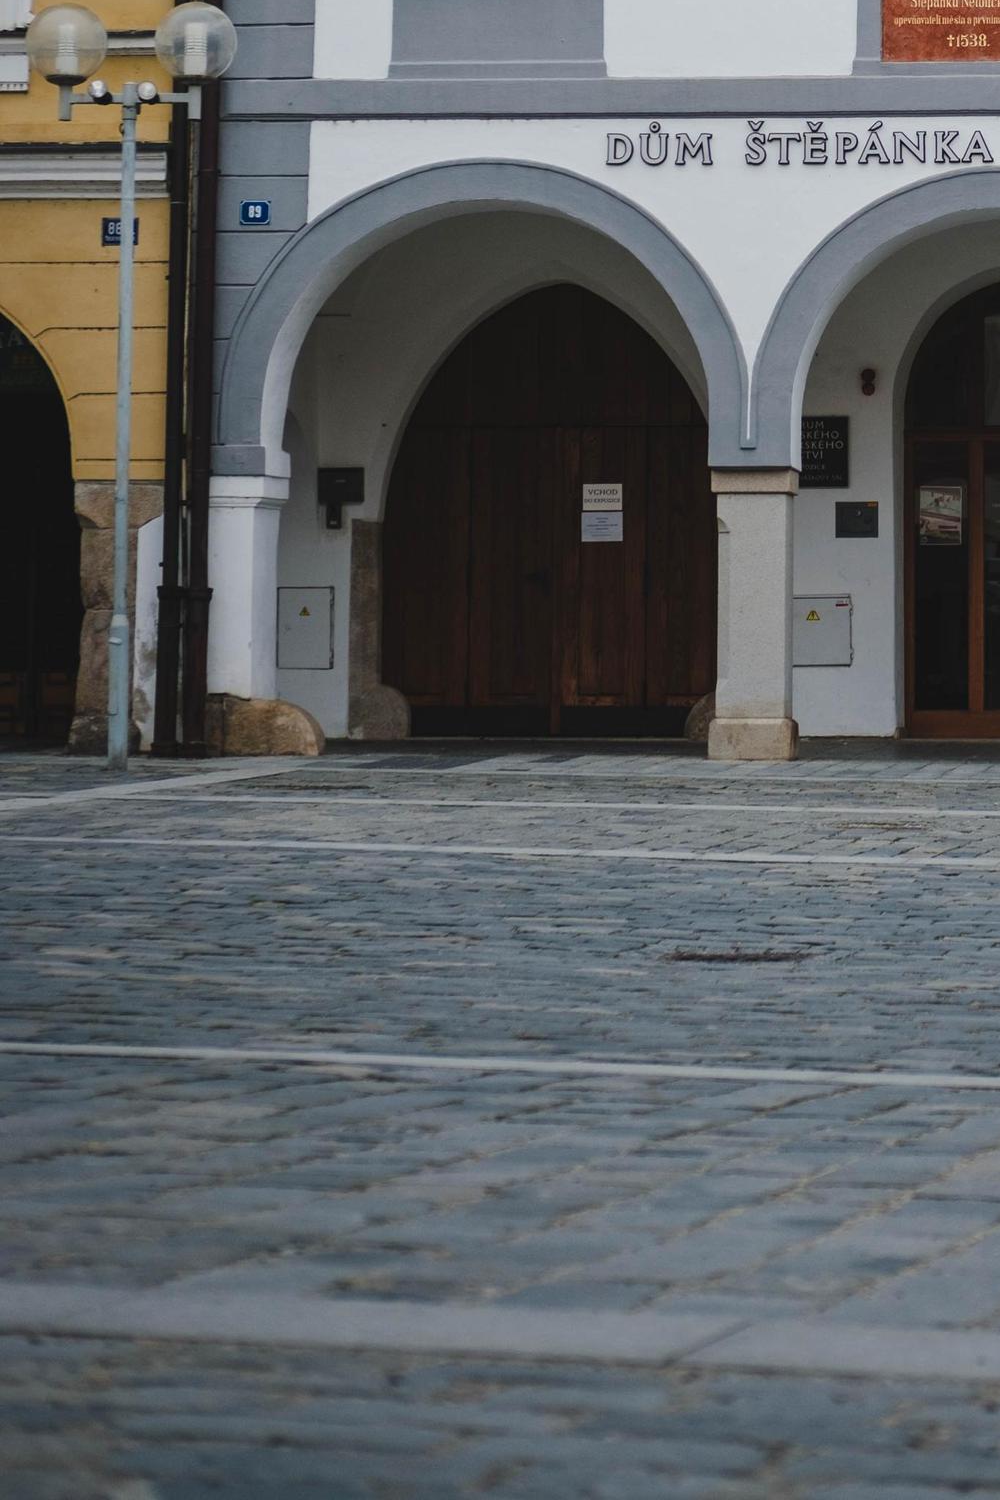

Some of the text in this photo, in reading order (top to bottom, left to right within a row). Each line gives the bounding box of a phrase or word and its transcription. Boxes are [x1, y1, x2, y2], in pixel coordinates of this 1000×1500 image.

[605, 121, 713, 166] DŮM
[744, 120, 994, 165] ŠTĚPÁNKA
[248, 205, 262, 218] 89
